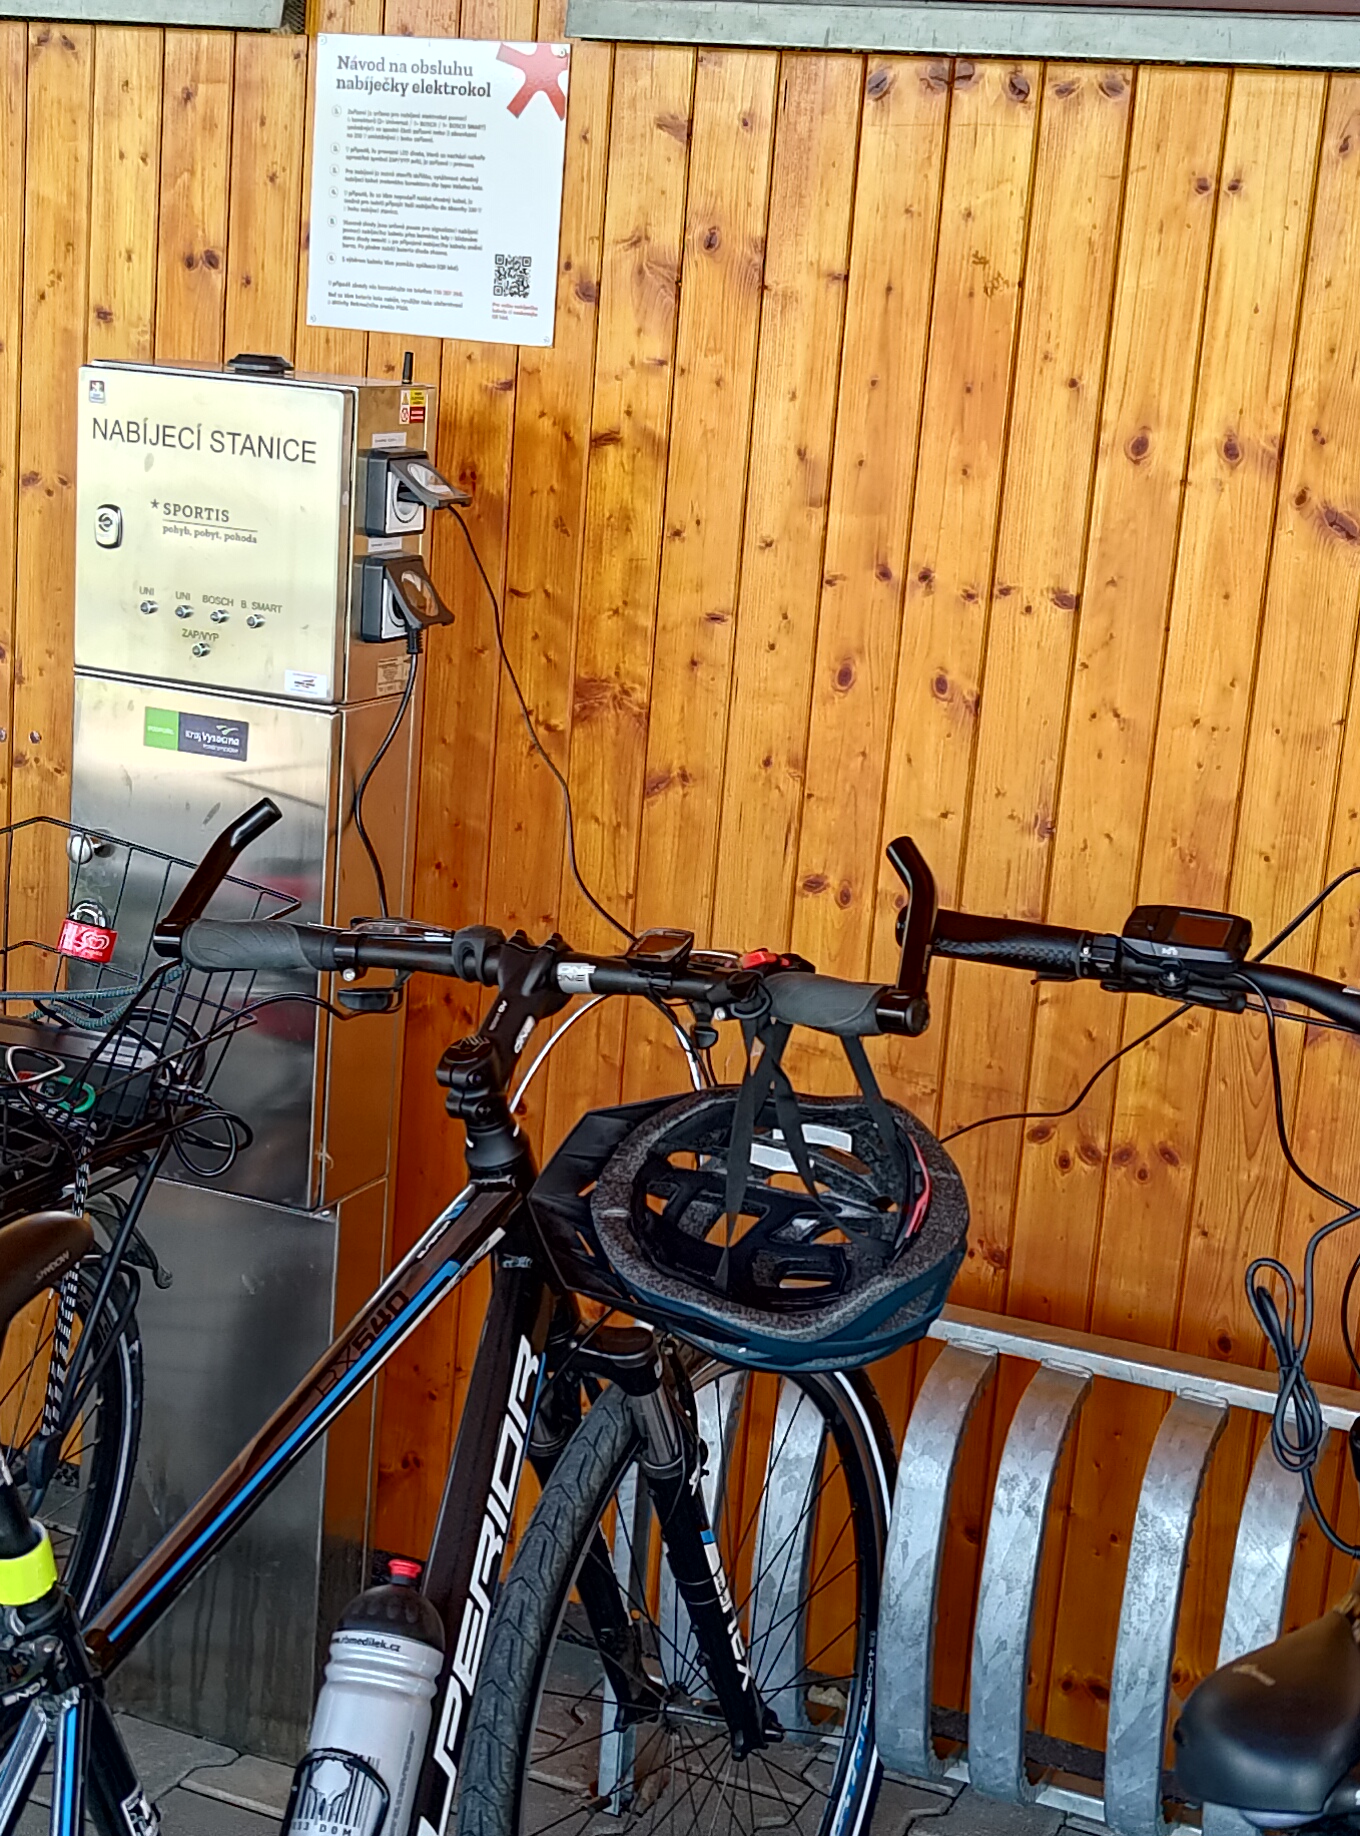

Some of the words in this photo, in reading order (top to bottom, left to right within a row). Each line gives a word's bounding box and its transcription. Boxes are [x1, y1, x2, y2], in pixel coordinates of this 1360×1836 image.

[337, 55, 385, 72] Návod
[389, 62, 407, 73] na
[411, 59, 473, 77] obsluhu
[336, 75, 409, 97] nabíječky
[412, 79, 491, 97] elektrokol
[92, 417, 202, 451] NABÍJECÍ
[210, 430, 317, 464] STANICE
[163, 502, 230, 522] SPORTIS
[194, 527, 222, 541] pobyt,
[224, 531, 257, 544] pohoda
[139, 586, 155, 596] UNI
[175, 591, 191, 601] UNI
[202, 595, 234, 606] BOSCH
[251, 601, 282, 614] SMART
[181, 628, 220, 641] ZAP/VYP
